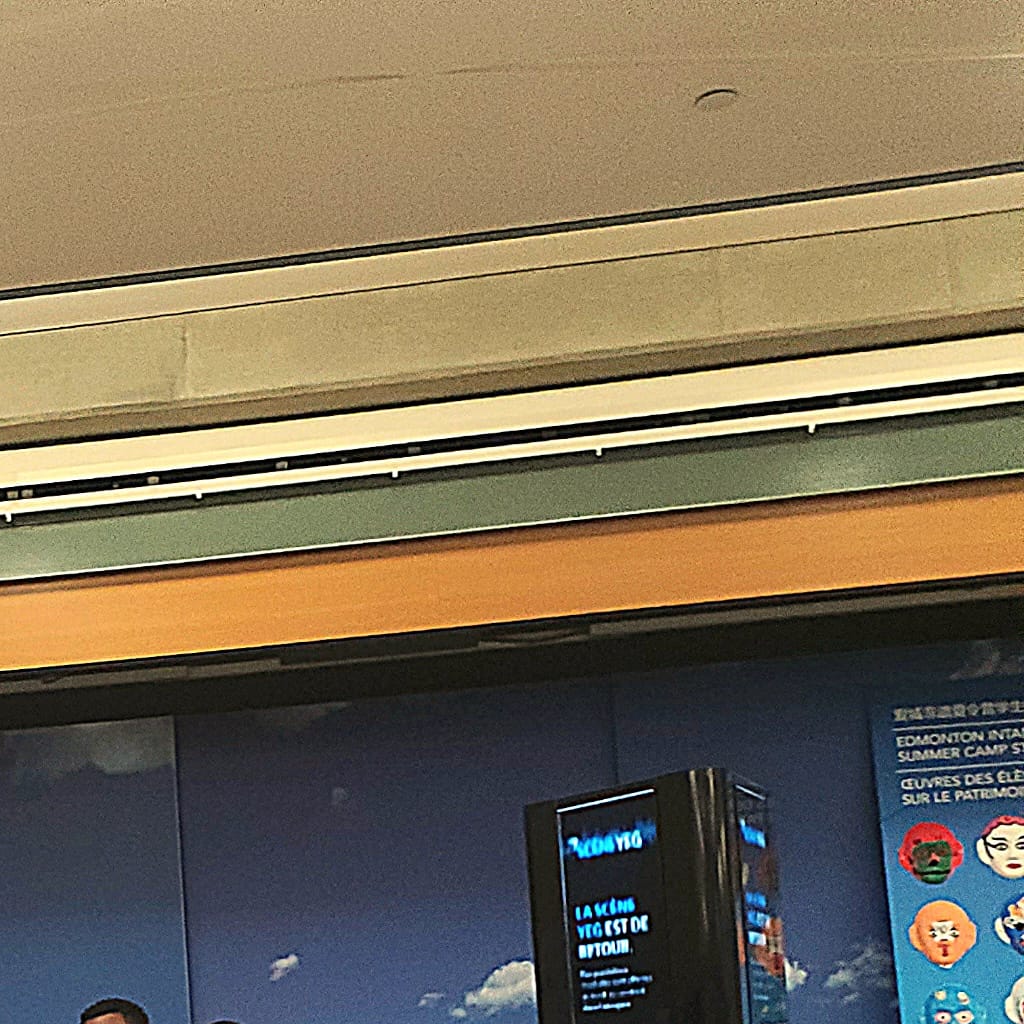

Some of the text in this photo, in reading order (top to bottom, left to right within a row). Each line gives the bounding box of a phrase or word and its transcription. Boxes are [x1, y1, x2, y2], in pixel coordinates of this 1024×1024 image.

[897, 727, 1024, 748] EDMONTON INTA
[898, 747, 960, 762] SUMMER
[964, 744, 1008, 758] CAMP
[964, 773, 994, 787] DES
[997, 768, 1024, 784] ÉLÈ
[902, 792, 931, 806] SUR
[934, 790, 952, 803] LE
[604, 918, 628, 937] EST
